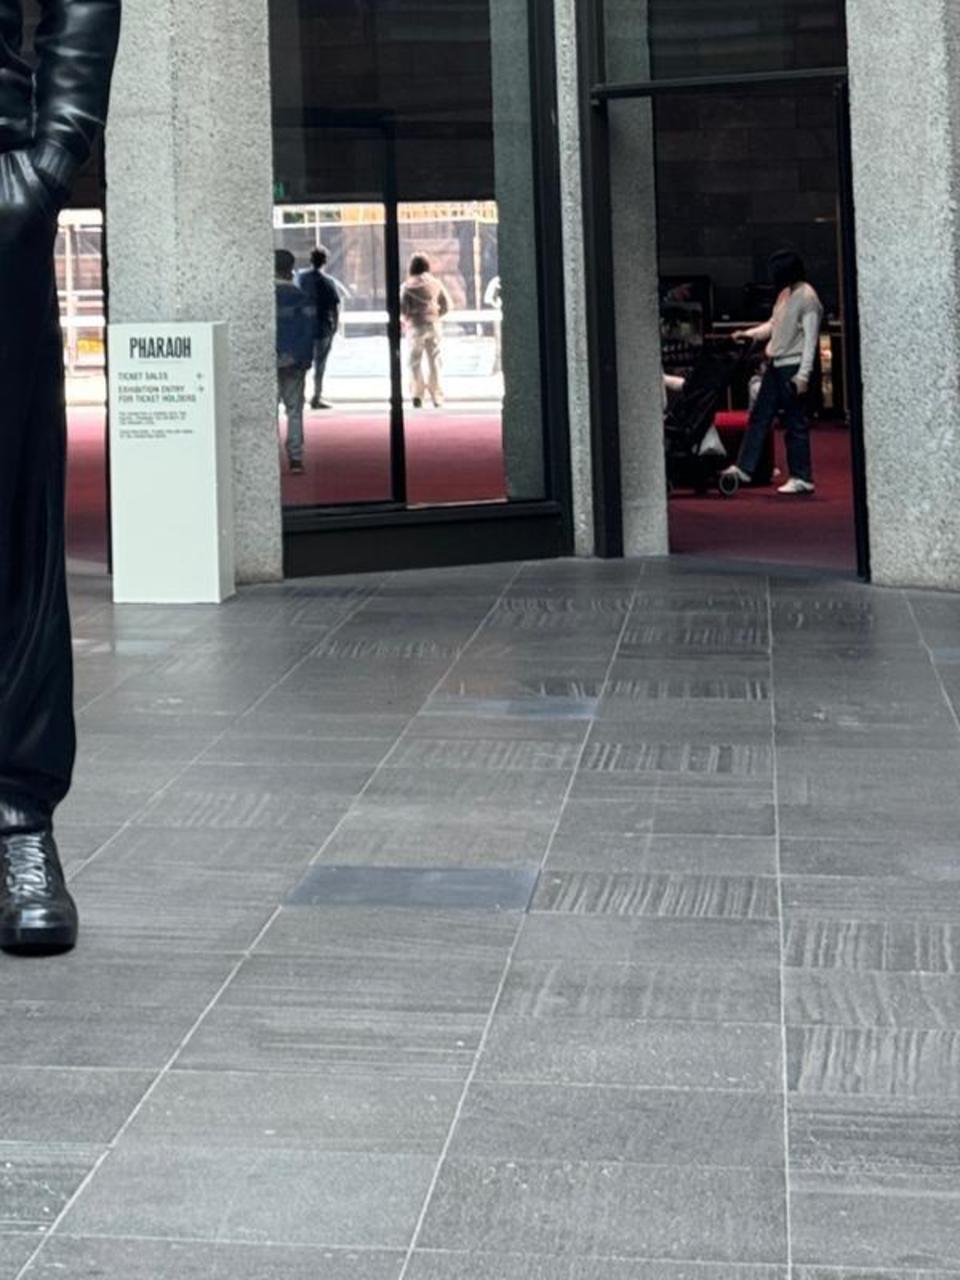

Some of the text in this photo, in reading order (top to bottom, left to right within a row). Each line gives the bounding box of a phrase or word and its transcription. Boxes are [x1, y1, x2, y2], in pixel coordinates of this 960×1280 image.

[129, 336, 192, 359] PHARAOH
[118, 371, 169, 381] TICKET SALES
[118, 384, 185, 394] EXHIBITION ENTRY
[118, 393, 197, 403] FOR TICKET HOLDERS
